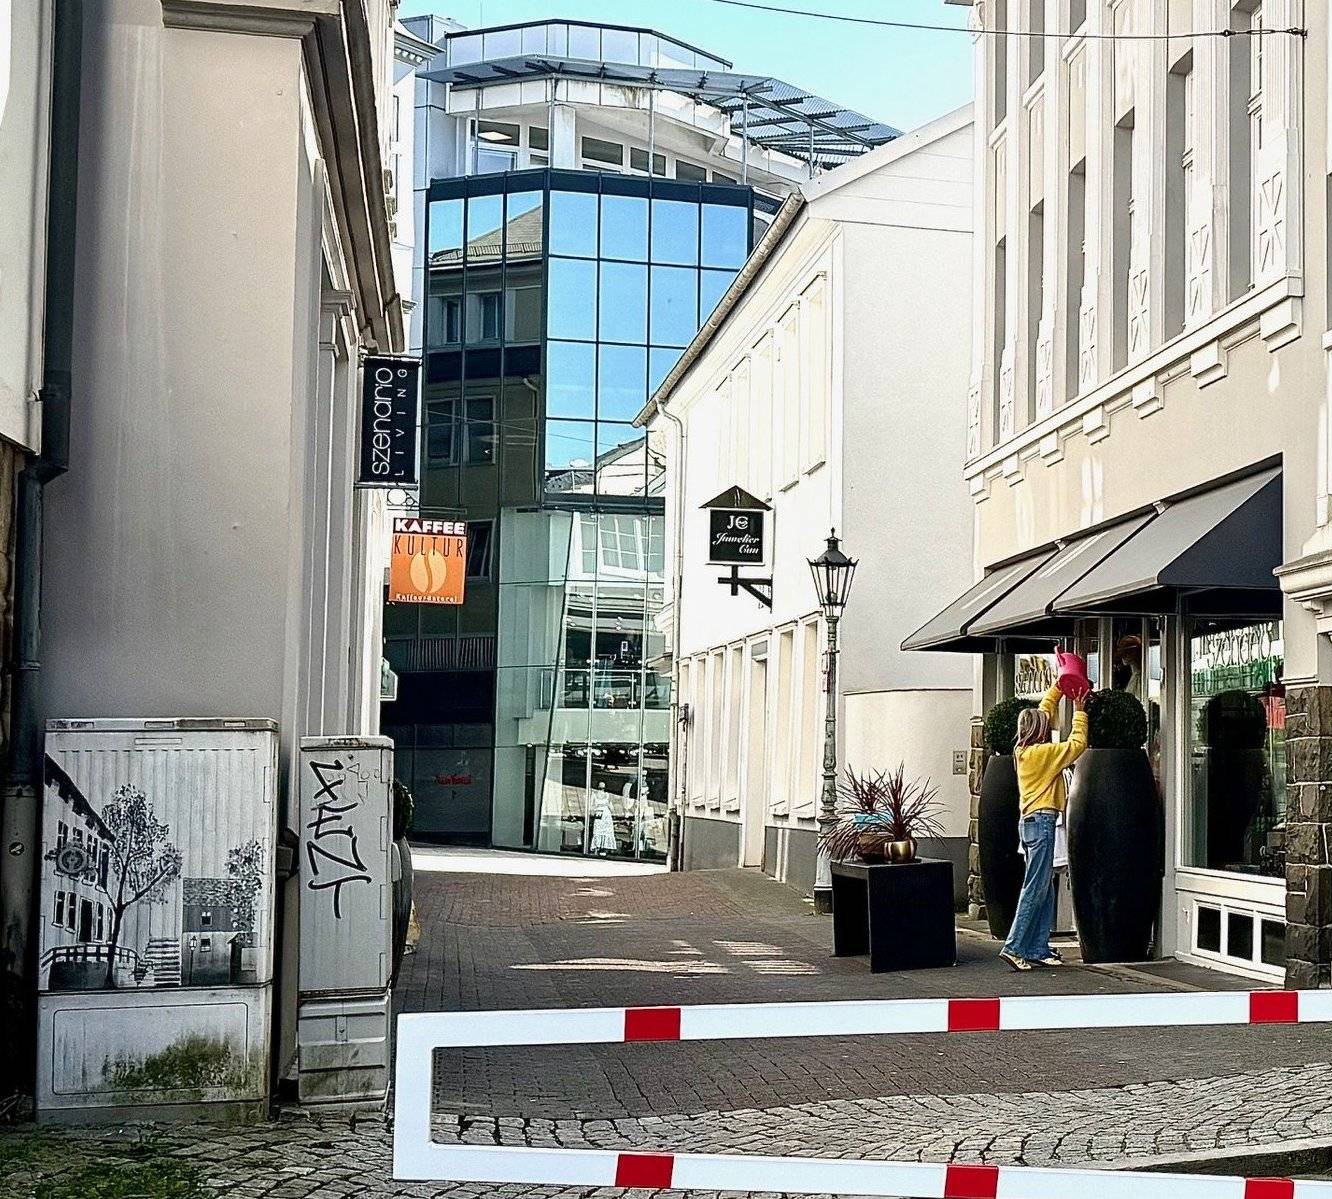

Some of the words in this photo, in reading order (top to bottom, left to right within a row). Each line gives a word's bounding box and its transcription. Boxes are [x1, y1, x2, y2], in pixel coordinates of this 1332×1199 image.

[371, 367, 393, 475] szenario
[394, 368, 408, 477] LIVING
[393, 535, 464, 558] KULTUR
[394, 519, 466, 535] KAFFEE
